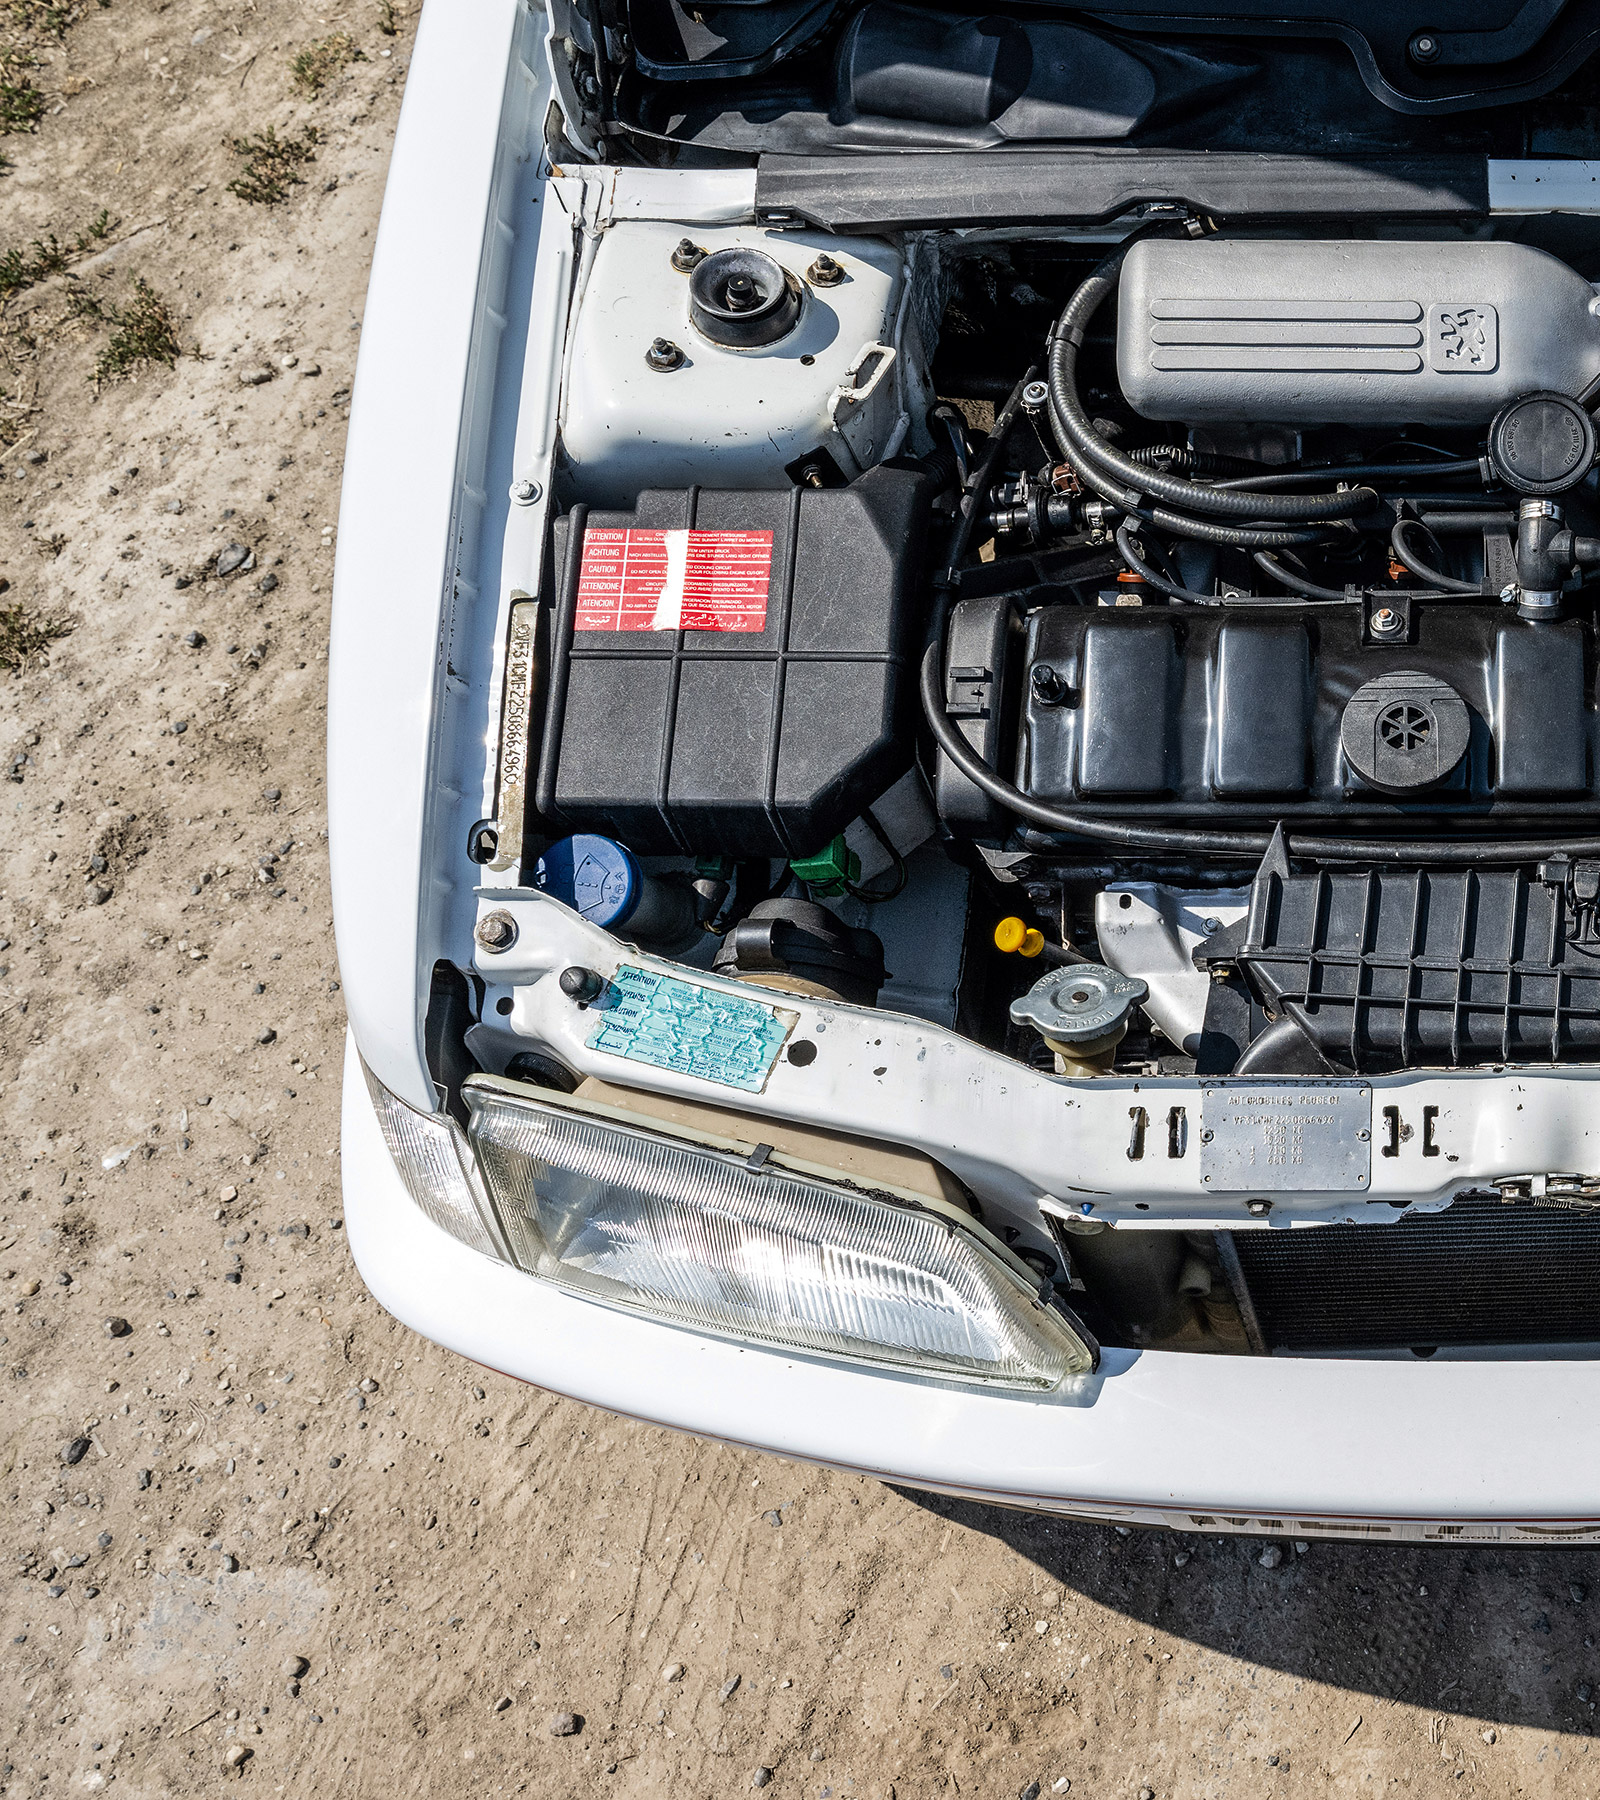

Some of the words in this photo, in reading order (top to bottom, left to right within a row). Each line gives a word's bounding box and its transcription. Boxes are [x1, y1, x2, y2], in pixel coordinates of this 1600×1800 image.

[588, 532, 624, 541] ATTENTION
[588, 548, 620, 557] ACHTUNG
[588, 565, 617, 573] CAUTION
[581, 582, 620, 590] ATTENZIONE
[581, 599, 615, 607] ATENCION
[620, 970, 657, 987] ATTENTION
[609, 1004, 639, 1019] CAUTION
[1052, 1009, 1115, 1029] TIGHTEN
[1227, 1095, 1293, 1106] AUTOMOBILES
[1298, 1095, 1340, 1105] PEUGEOT
